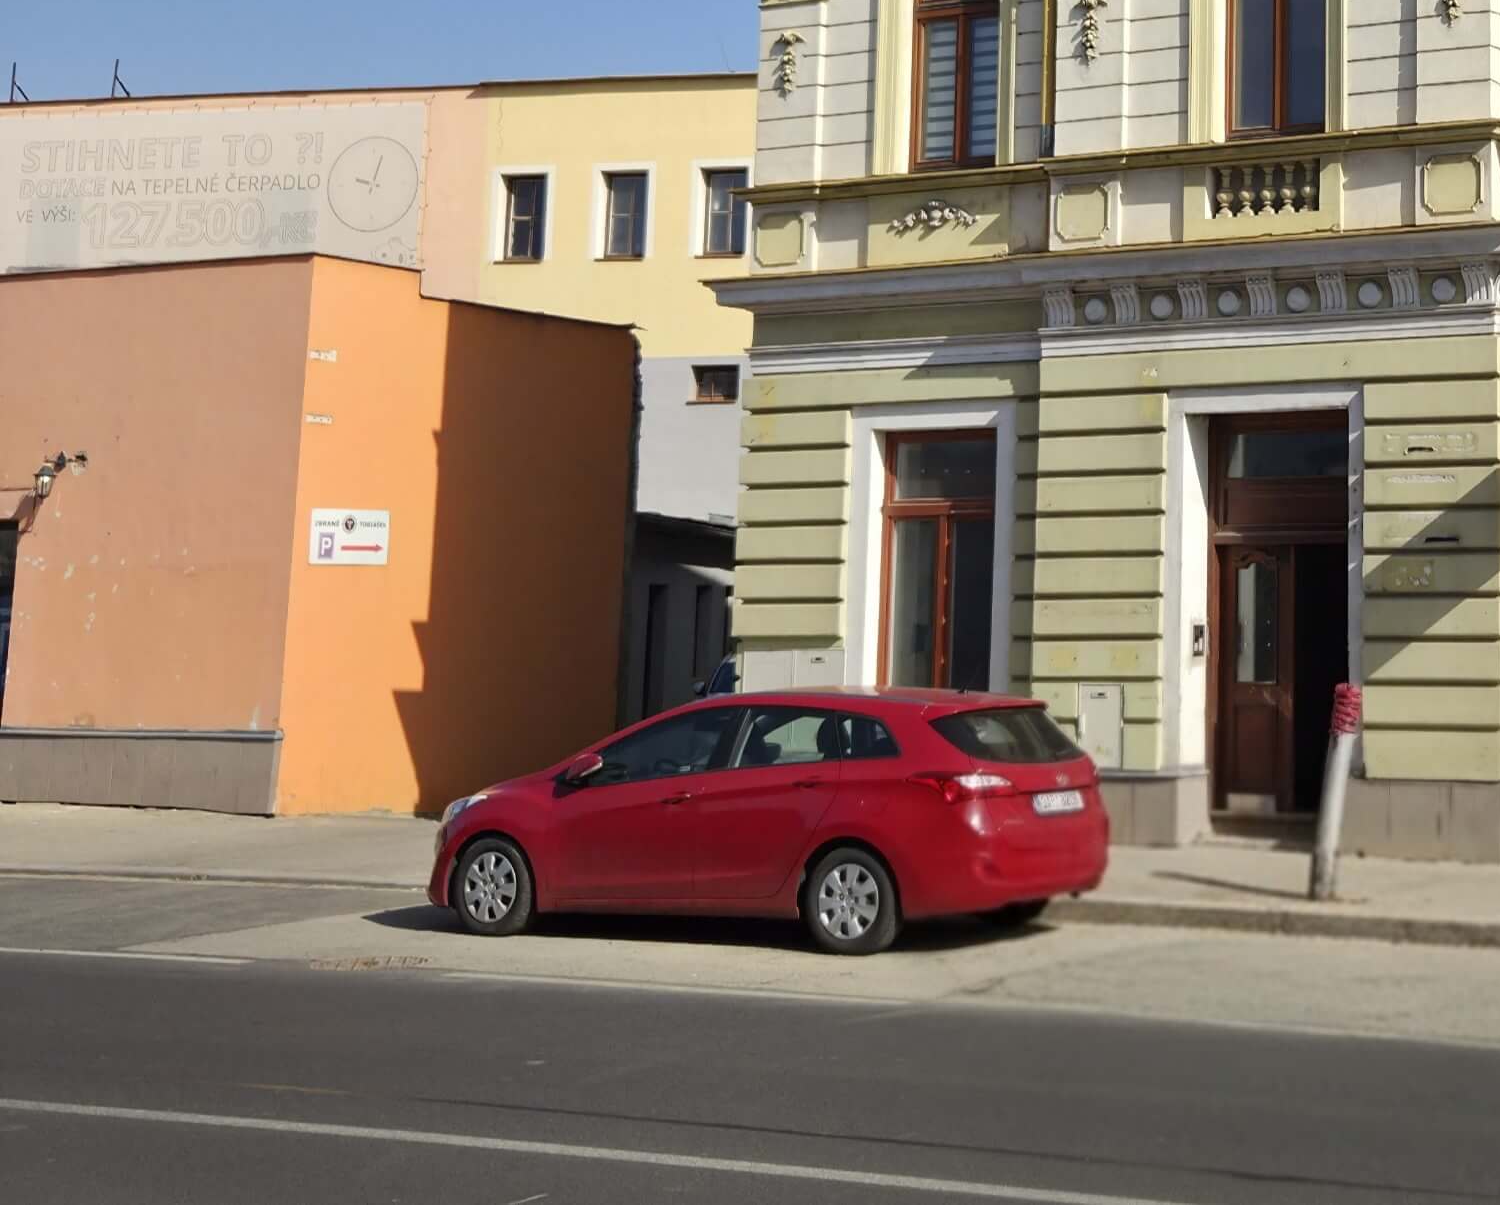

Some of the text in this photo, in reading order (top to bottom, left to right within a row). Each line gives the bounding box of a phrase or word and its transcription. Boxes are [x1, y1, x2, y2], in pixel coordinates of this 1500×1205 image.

[20, 130, 324, 174] STIHNETE TO ?!
[111, 178, 137, 196] NA
[143, 172, 219, 195] TEPELNÉ
[225, 171, 321, 193] ČERPADLO
[16, 208, 33, 224] VE
